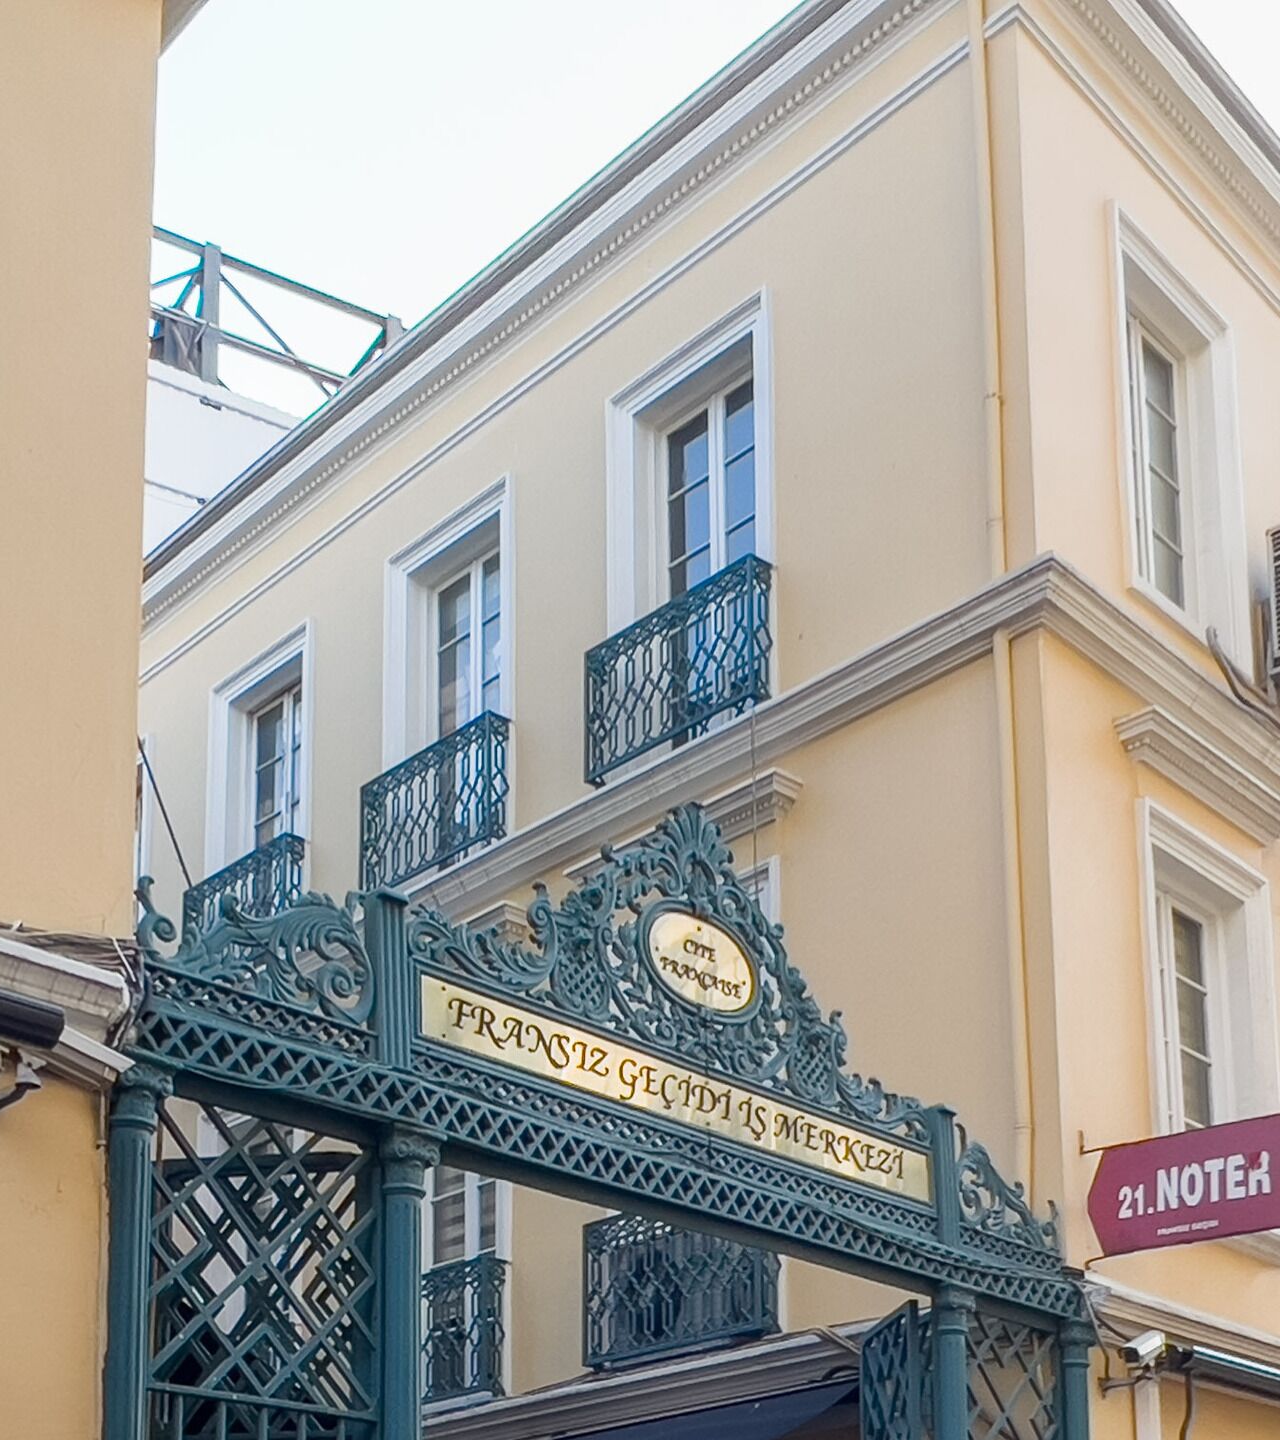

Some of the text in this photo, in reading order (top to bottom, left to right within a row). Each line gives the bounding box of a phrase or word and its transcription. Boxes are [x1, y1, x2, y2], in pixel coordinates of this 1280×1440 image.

[448, 997, 906, 1181] FRANSIZ GEÇİDİ İŞ MERKEZİ
